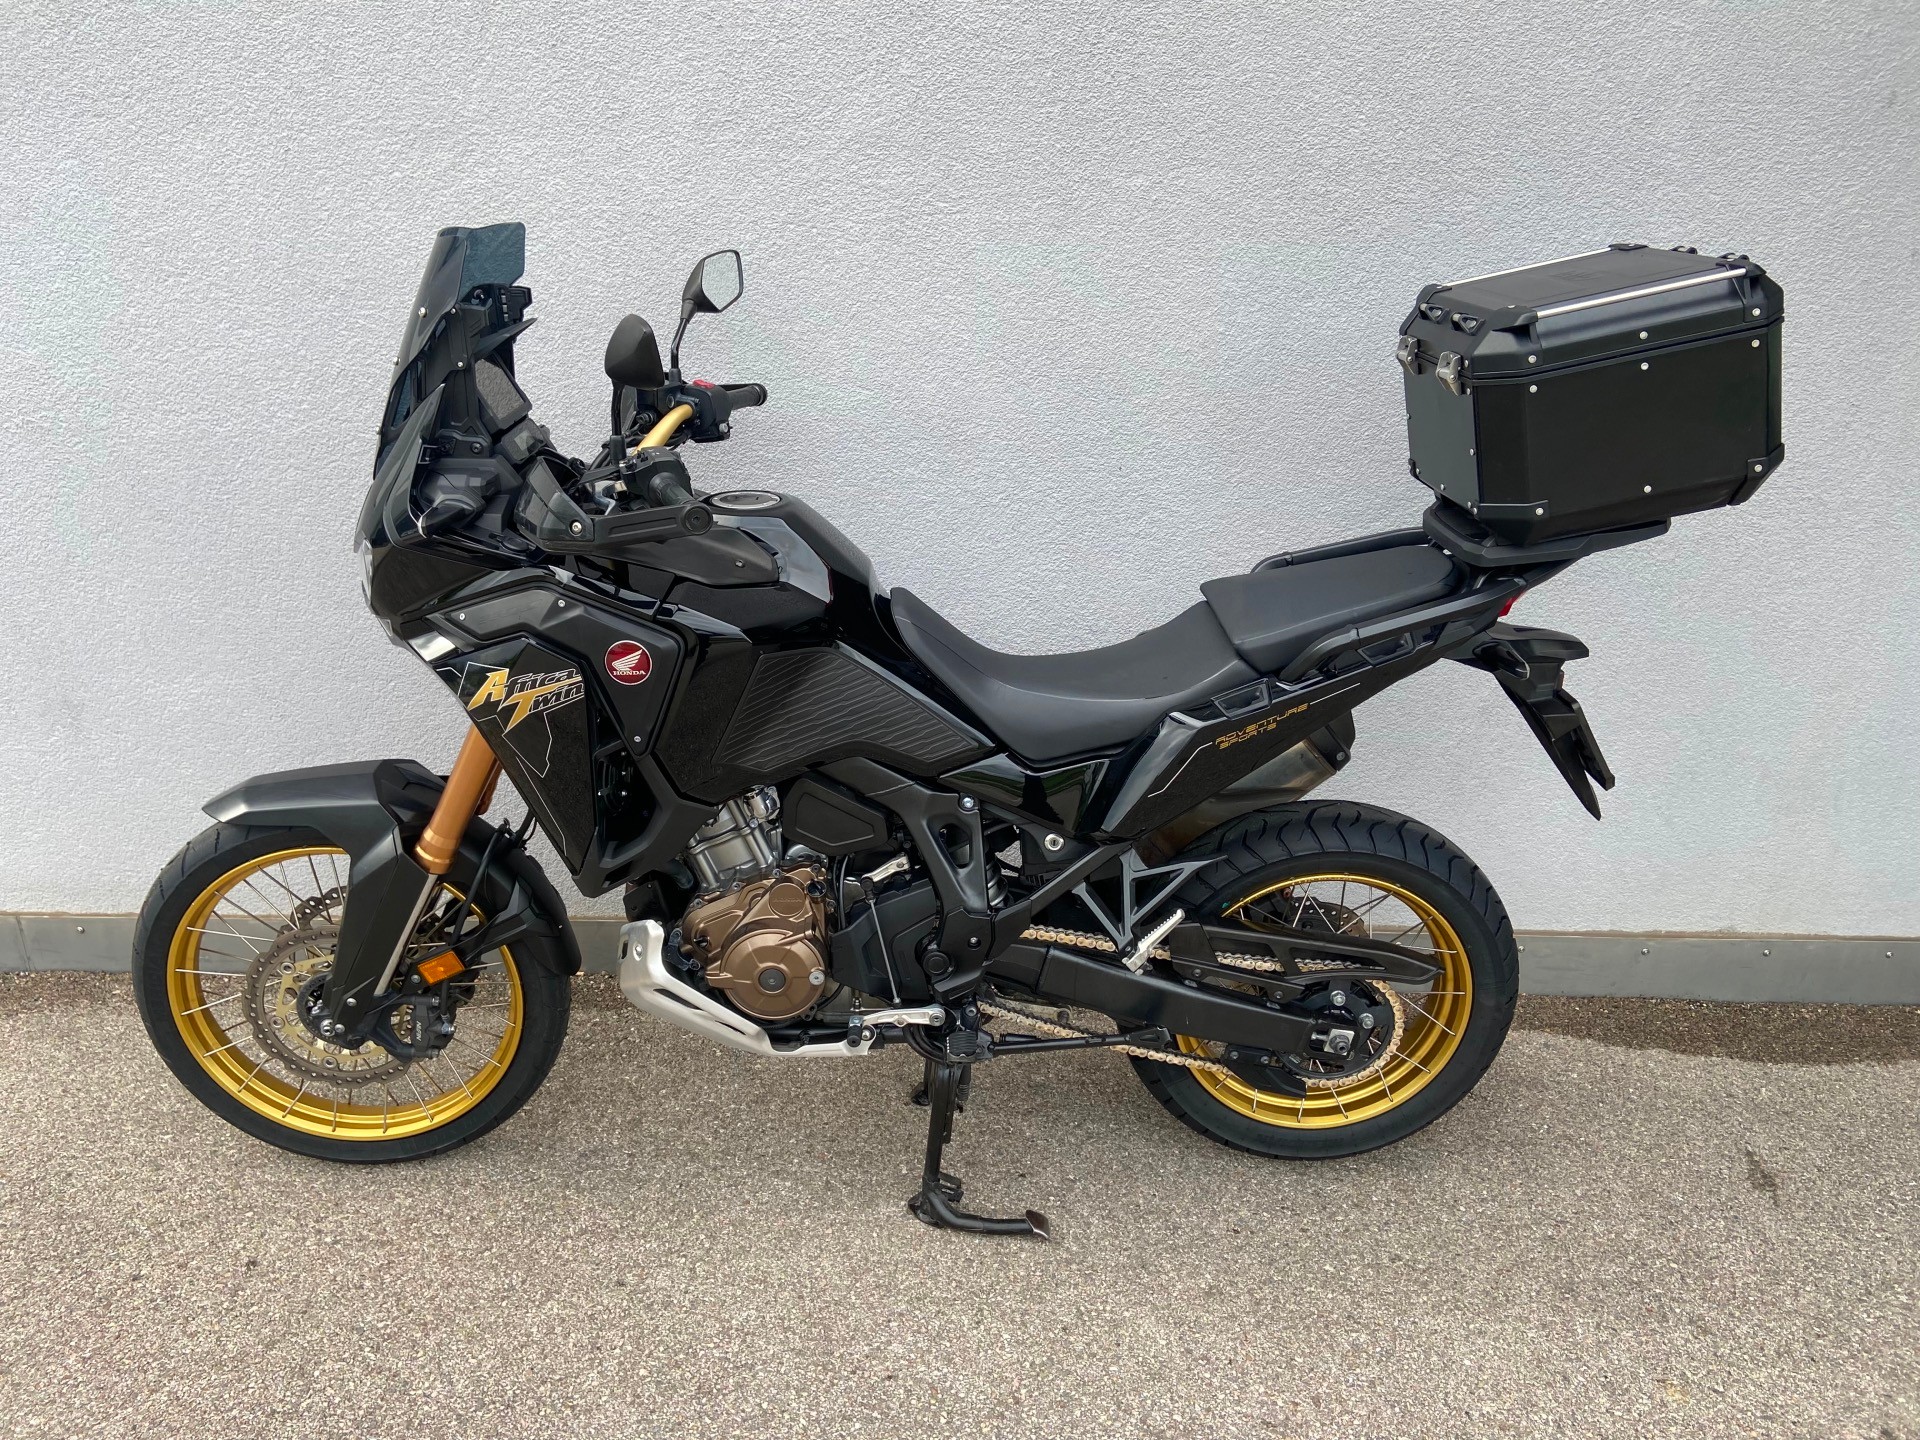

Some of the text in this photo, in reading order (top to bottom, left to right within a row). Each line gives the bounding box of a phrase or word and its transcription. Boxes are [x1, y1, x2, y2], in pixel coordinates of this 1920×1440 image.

[466, 668, 582, 712] Africa
[501, 676, 585, 733] Twin
[1215, 703, 1310, 745] ADVENTURE
[1218, 722, 1277, 749] SPORTS
